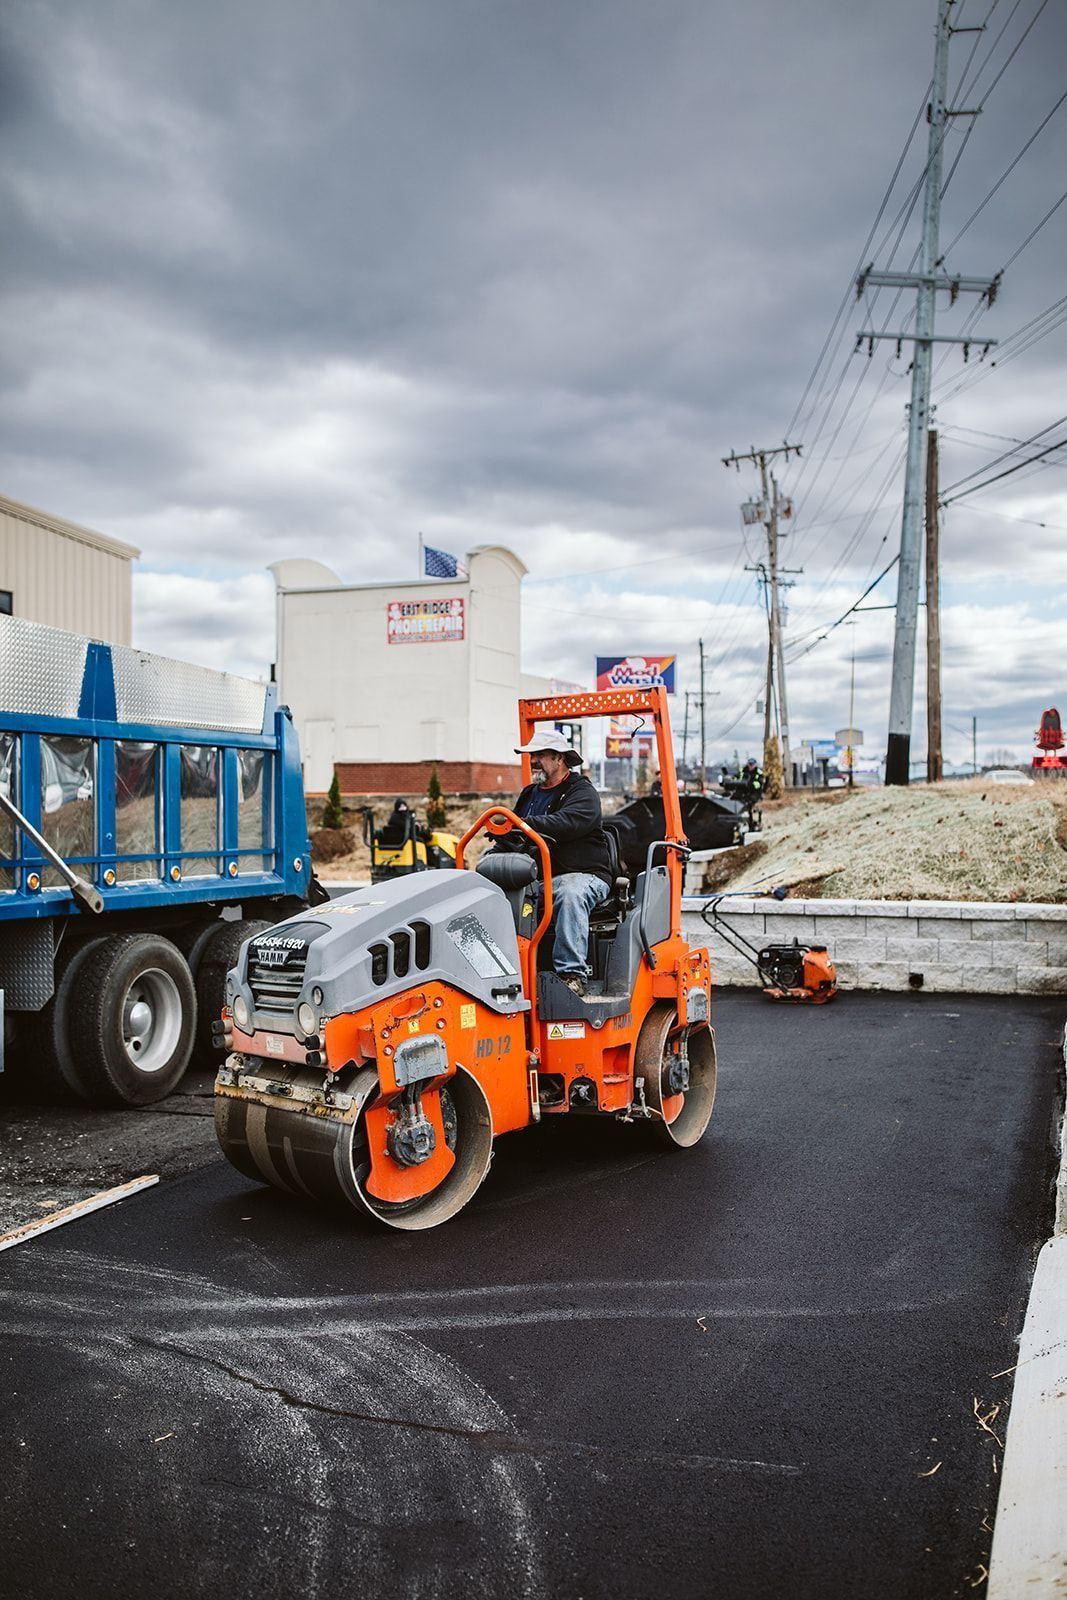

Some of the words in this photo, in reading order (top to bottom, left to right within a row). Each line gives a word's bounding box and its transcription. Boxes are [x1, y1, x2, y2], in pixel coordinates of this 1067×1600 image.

[401, 604, 420, 616] EAST
[423, 602, 450, 615] RIDGE
[616, 667, 657, 676] Mod
[611, 676, 661, 684] Wash
[260, 951, 284, 963] HAMM
[476, 1038, 494, 1058] HD
[497, 1035, 511, 1055] 12
